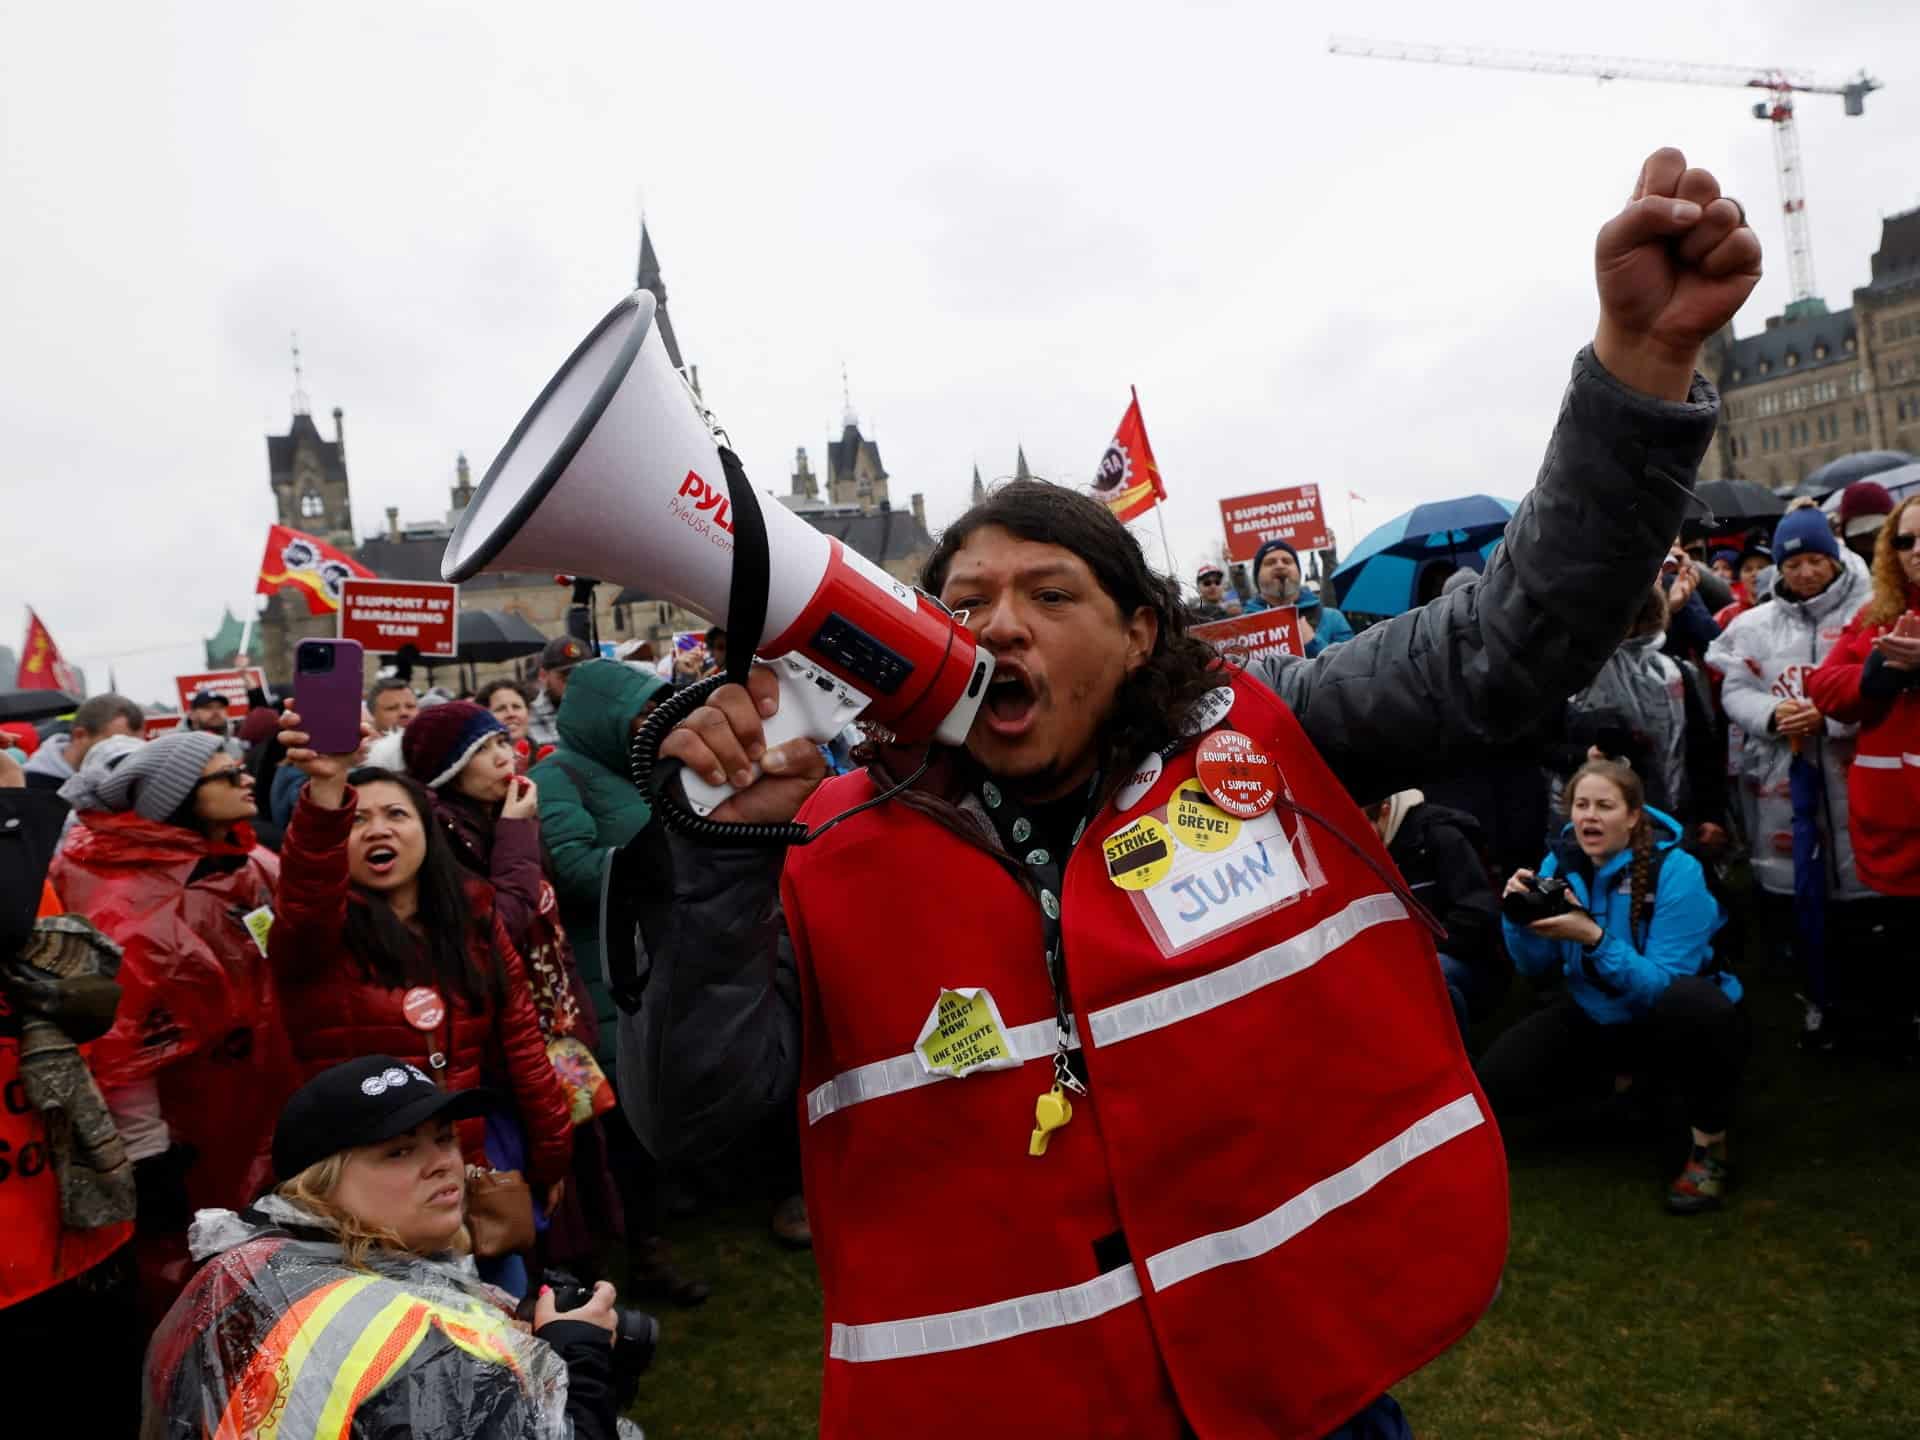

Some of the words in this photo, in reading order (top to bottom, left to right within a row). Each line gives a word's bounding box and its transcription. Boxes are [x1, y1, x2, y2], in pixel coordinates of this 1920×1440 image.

[678, 470, 735, 535] PYL
[1226, 511, 1232, 522] I
[1234, 501, 1295, 520] SUPPORT
[1297, 497, 1316, 510] MY
[1232, 511, 1315, 534] BARGAINING
[1258, 527, 1296, 543] TEAM
[355, 595, 425, 609] SUPPORT
[427, 599, 449, 611] MY
[352, 609, 444, 624] BARGAINING
[377, 624, 419, 636] TEAM
[1268, 624, 1290, 642] MY
[1234, 753, 1245, 763] DE
[1227, 780, 1262, 791] SUPPORT
[1188, 803, 1198, 814] la
[1213, 787, 1257, 813] BARGAINING
[1256, 788, 1274, 809] TEAM
[1177, 814, 1229, 834] GRÈVE!
[1106, 827, 1158, 860] STRIKE
[1171, 841, 1275, 922] JUAN
[940, 1000, 956, 1015] AIR
[940, 1017, 969, 1039] NOW!
[932, 1047, 951, 1064] UNE
[951, 1024, 993, 1053] ENTENTE
